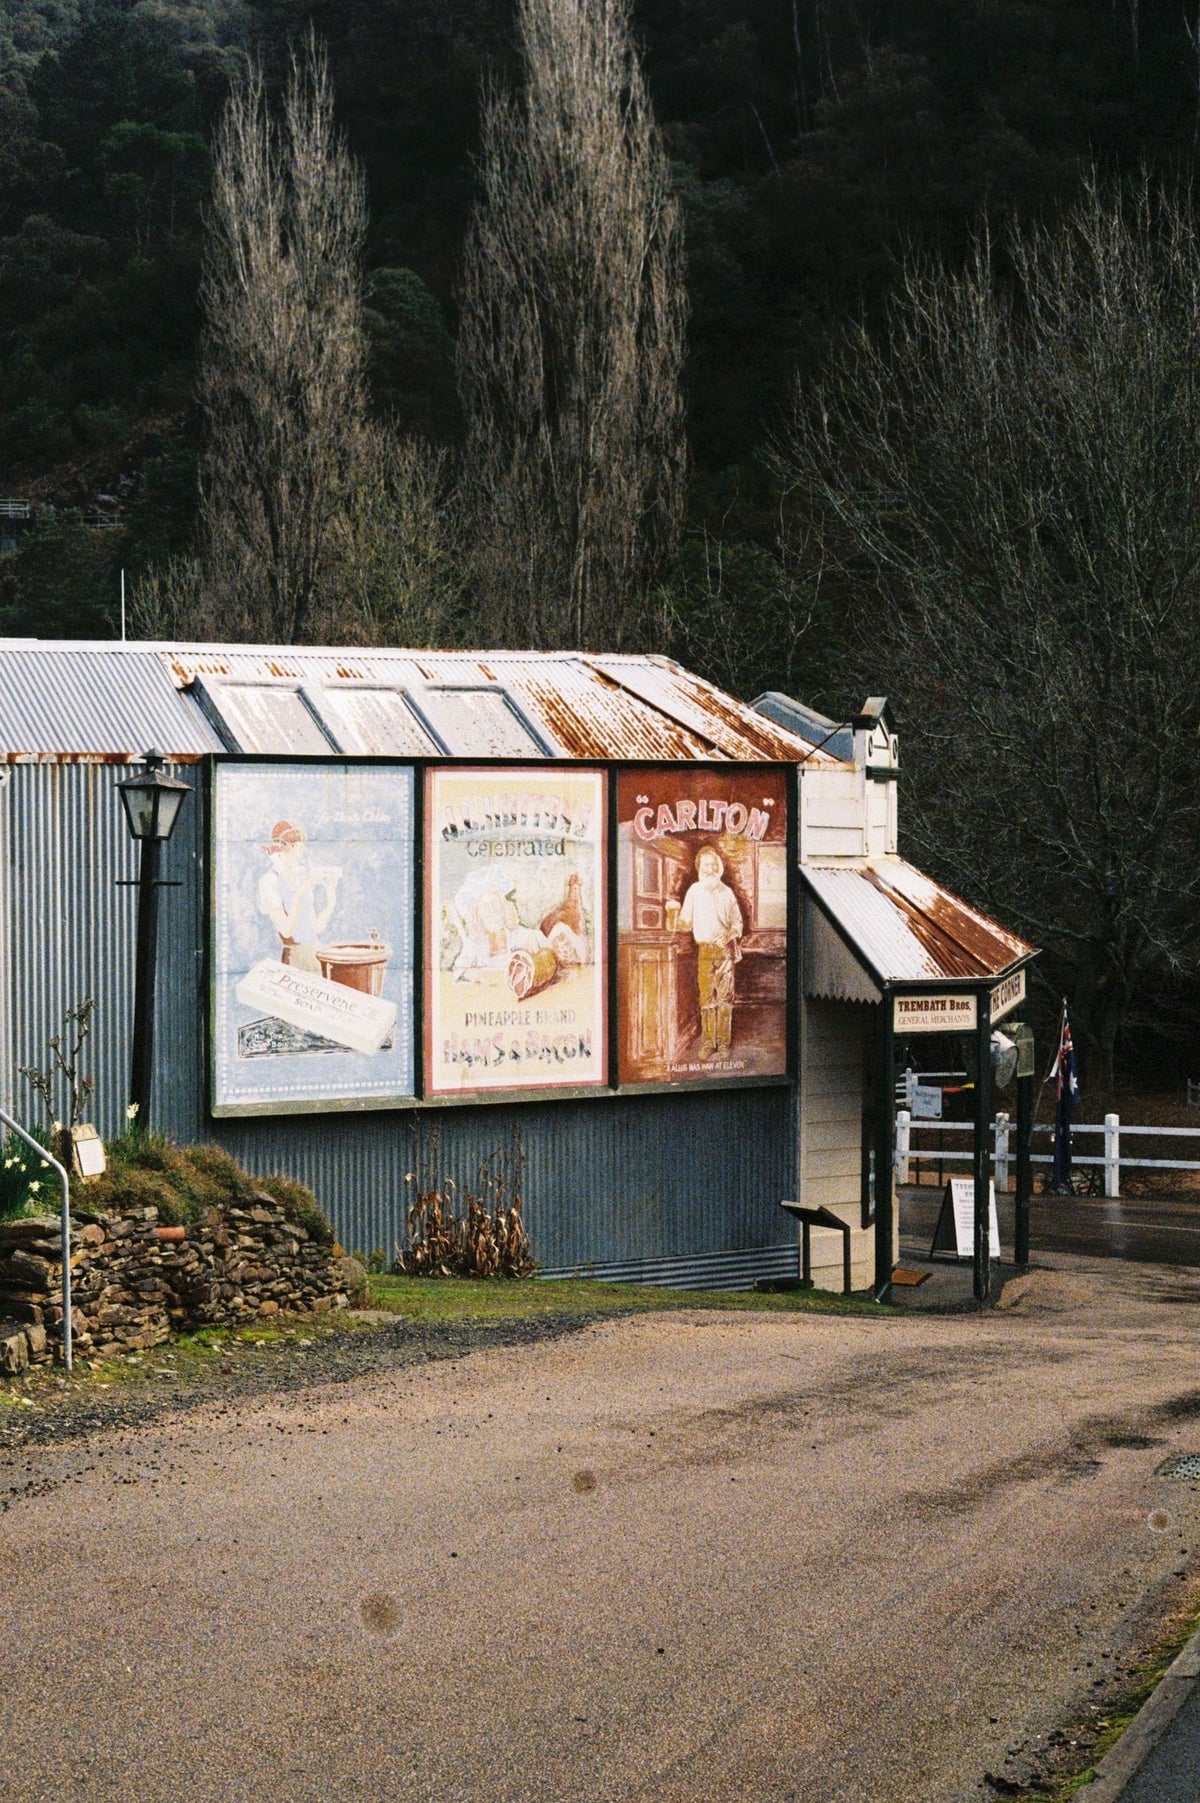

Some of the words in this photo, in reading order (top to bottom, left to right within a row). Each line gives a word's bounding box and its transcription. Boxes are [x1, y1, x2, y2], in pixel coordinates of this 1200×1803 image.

[467, 837, 566, 858] Celebrated
[278, 974, 358, 1012] Preservene
[294, 998, 322, 1011] SOAP
[898, 1000, 946, 1012] TREMBATH
[465, 1010, 531, 1027] PINEAPPLE
[536, 1009, 577, 1025] BRAND
[898, 1015, 929, 1025] GENERAL
[931, 1014, 970, 1024] MERCHANTS
[723, 1060, 745, 1070] ELEVEN
